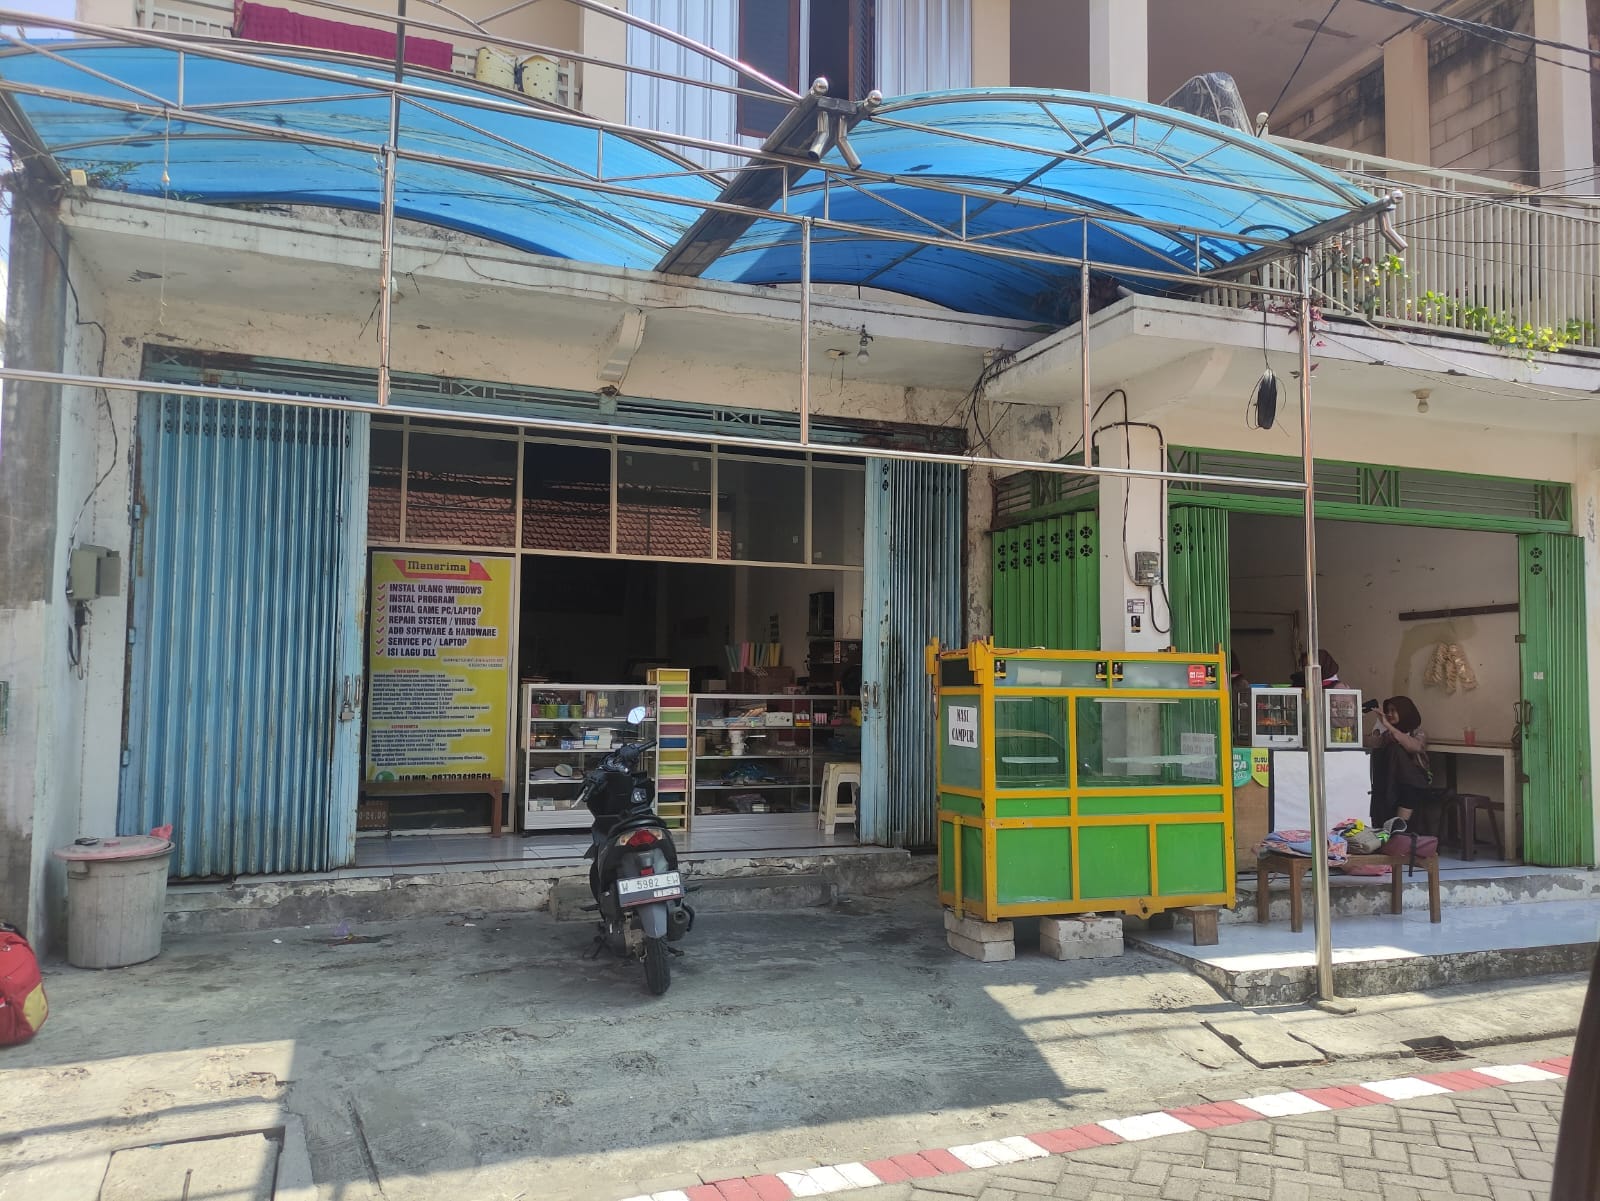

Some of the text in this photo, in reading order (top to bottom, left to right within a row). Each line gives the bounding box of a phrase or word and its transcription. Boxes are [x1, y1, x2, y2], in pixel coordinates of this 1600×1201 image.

[407, 560, 466, 572] Menerima
[389, 583, 482, 594] INSTAL ULANG WINDOWS
[389, 594, 455, 604] INSTAL PROGRAM
[389, 605, 482, 615] INSTAL GAME PC/LAPTOP
[388, 616, 415, 624] REPAIR
[418, 616, 447, 625] SYSTEM
[454, 617, 476, 625] VIRUS
[388, 627, 497, 636] ADD SOFTWARE & HARDWARE
[387, 637, 419, 645] SERVICE
[421, 638, 432, 646] PC
[439, 638, 467, 646] LAPTOP
[387, 648, 436, 657] ISI LAGU DLL
[956, 708, 969, 722] NASI
[951, 727, 975, 743] CAMPUR
